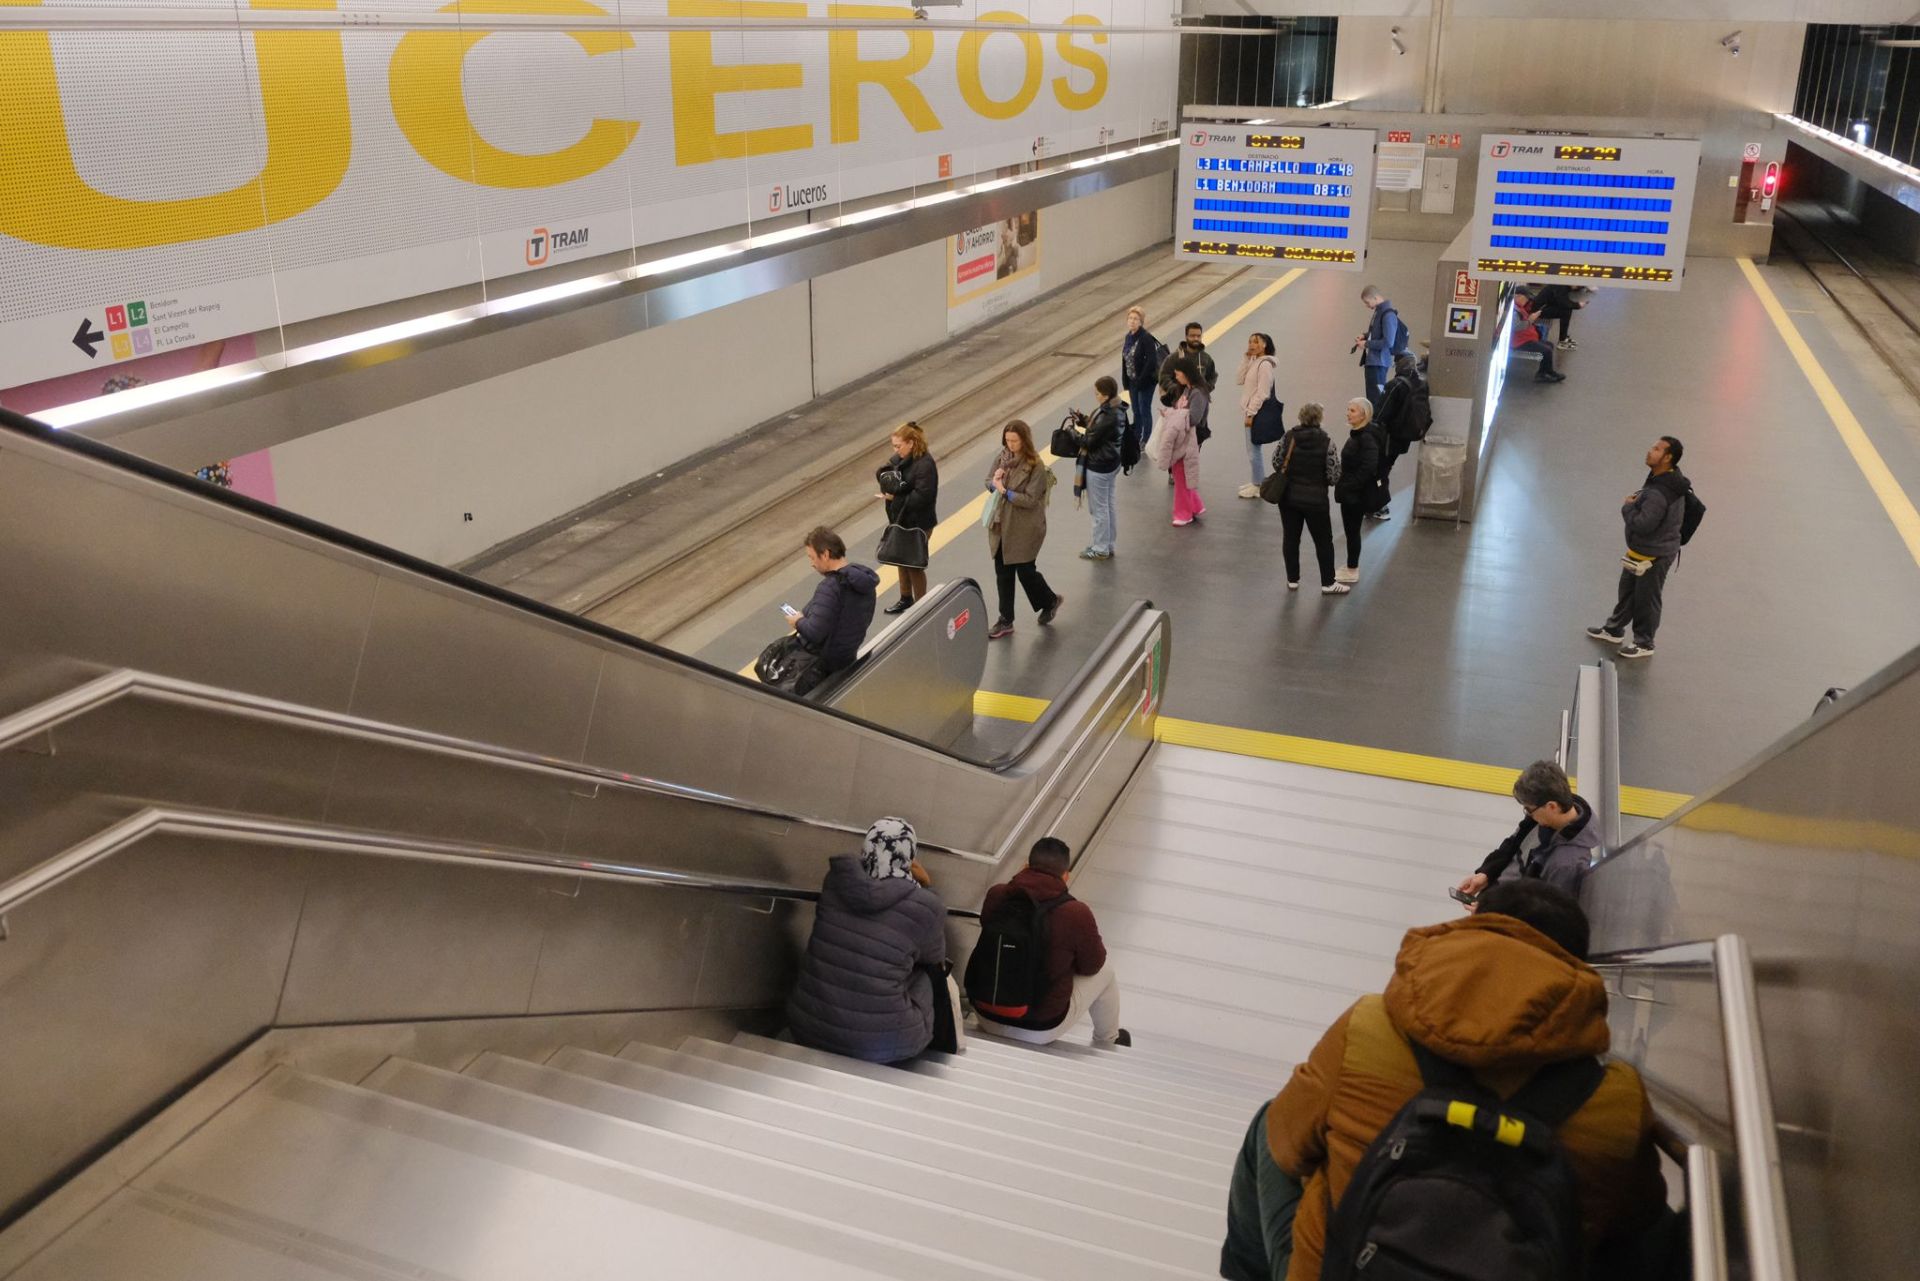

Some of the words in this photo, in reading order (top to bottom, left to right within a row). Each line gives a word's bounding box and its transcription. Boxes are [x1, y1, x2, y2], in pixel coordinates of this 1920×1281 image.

[1208, 134, 1236, 142] TRAM
[1512, 145, 1543, 154] TRAM
[1197, 158, 1211, 170] L3
[1218, 159, 1233, 170] EL
[1240, 160, 1300, 174] CAMPELLO
[1315, 163, 1353, 176] 07:48
[1196, 178, 1208, 190] L1
[1314, 183, 1352, 197] 08:10
[786, 184, 827, 207] Luceros
[551, 228, 588, 248] TRAM
[109, 313, 123, 325] L1
[130, 307, 145, 321] L2
[136, 334, 150, 347] L4
[166, 337, 173, 345] La
